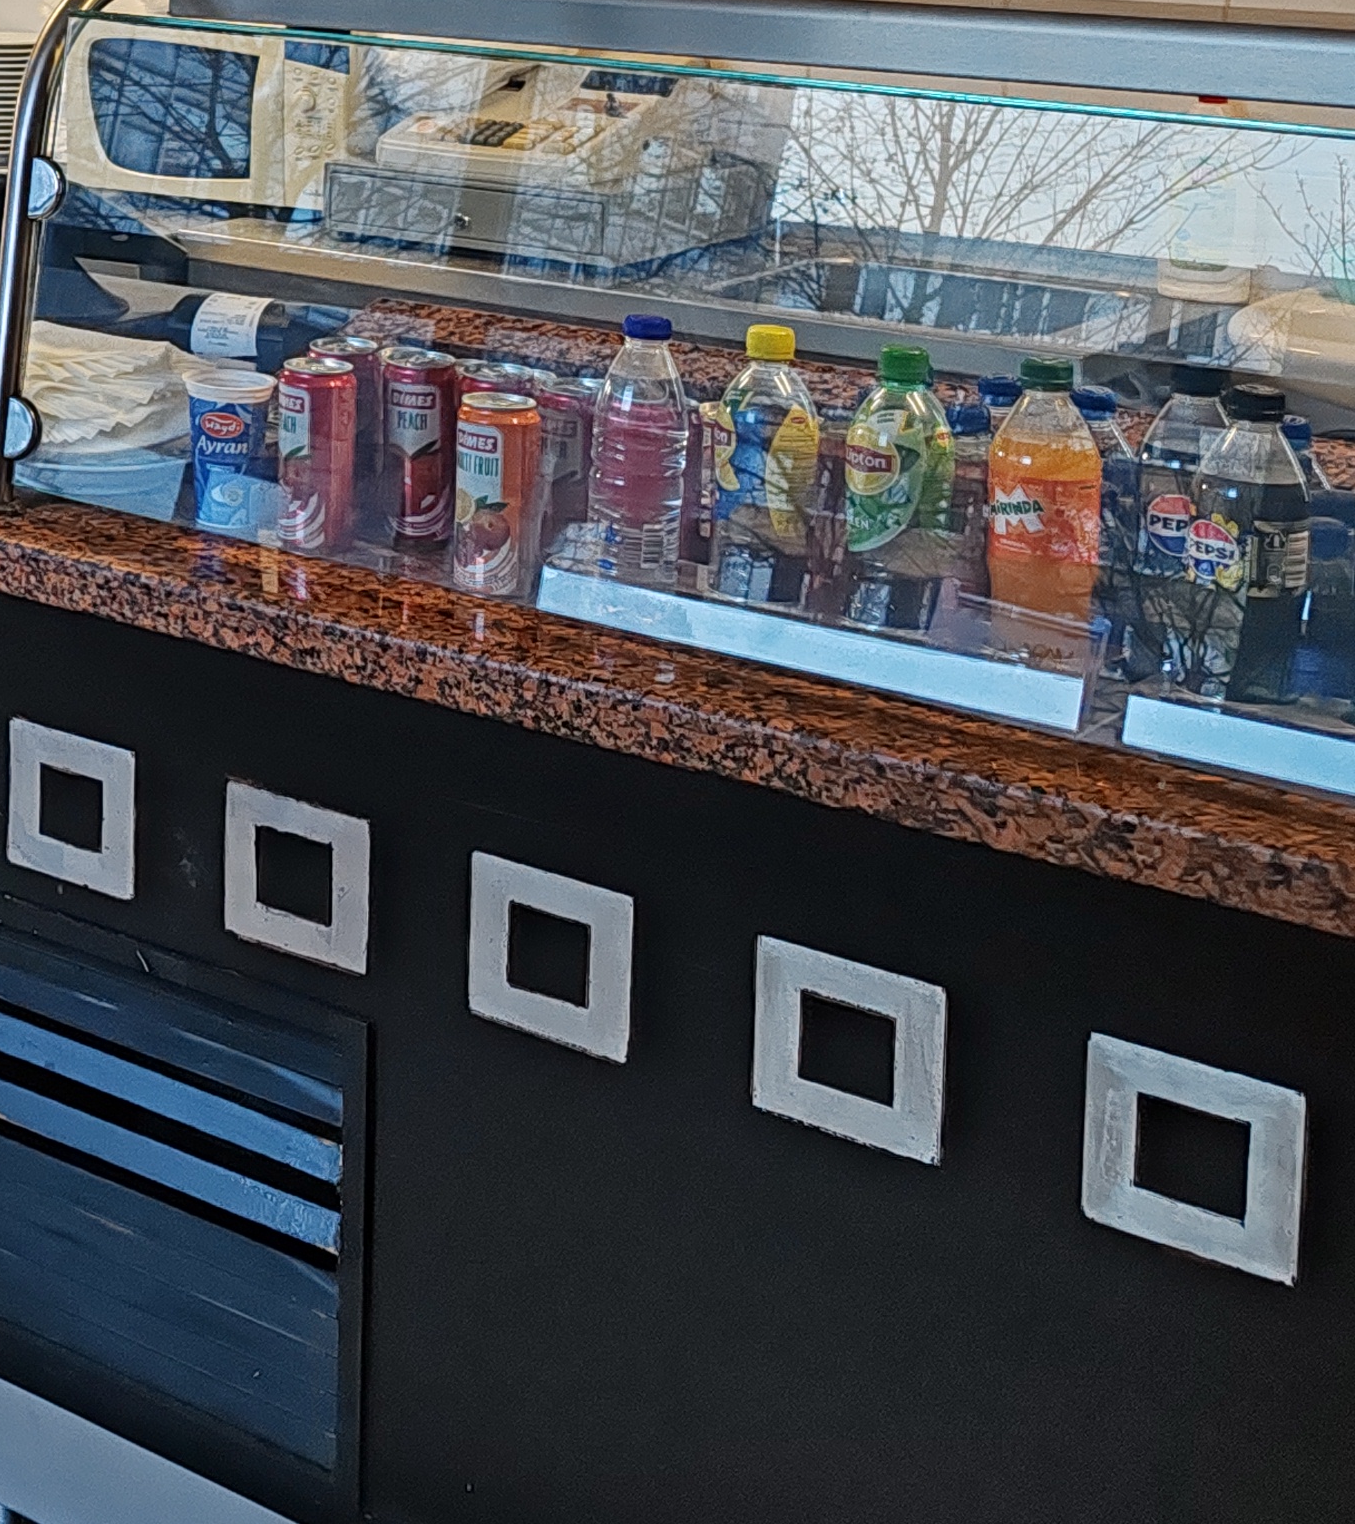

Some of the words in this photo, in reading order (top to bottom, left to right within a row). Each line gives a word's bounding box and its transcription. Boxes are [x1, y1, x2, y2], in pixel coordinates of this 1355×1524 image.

[197, 435, 249, 455] Ayran
[474, 455, 500, 477] FRUIT
[1150, 515, 1188, 532] PEP
